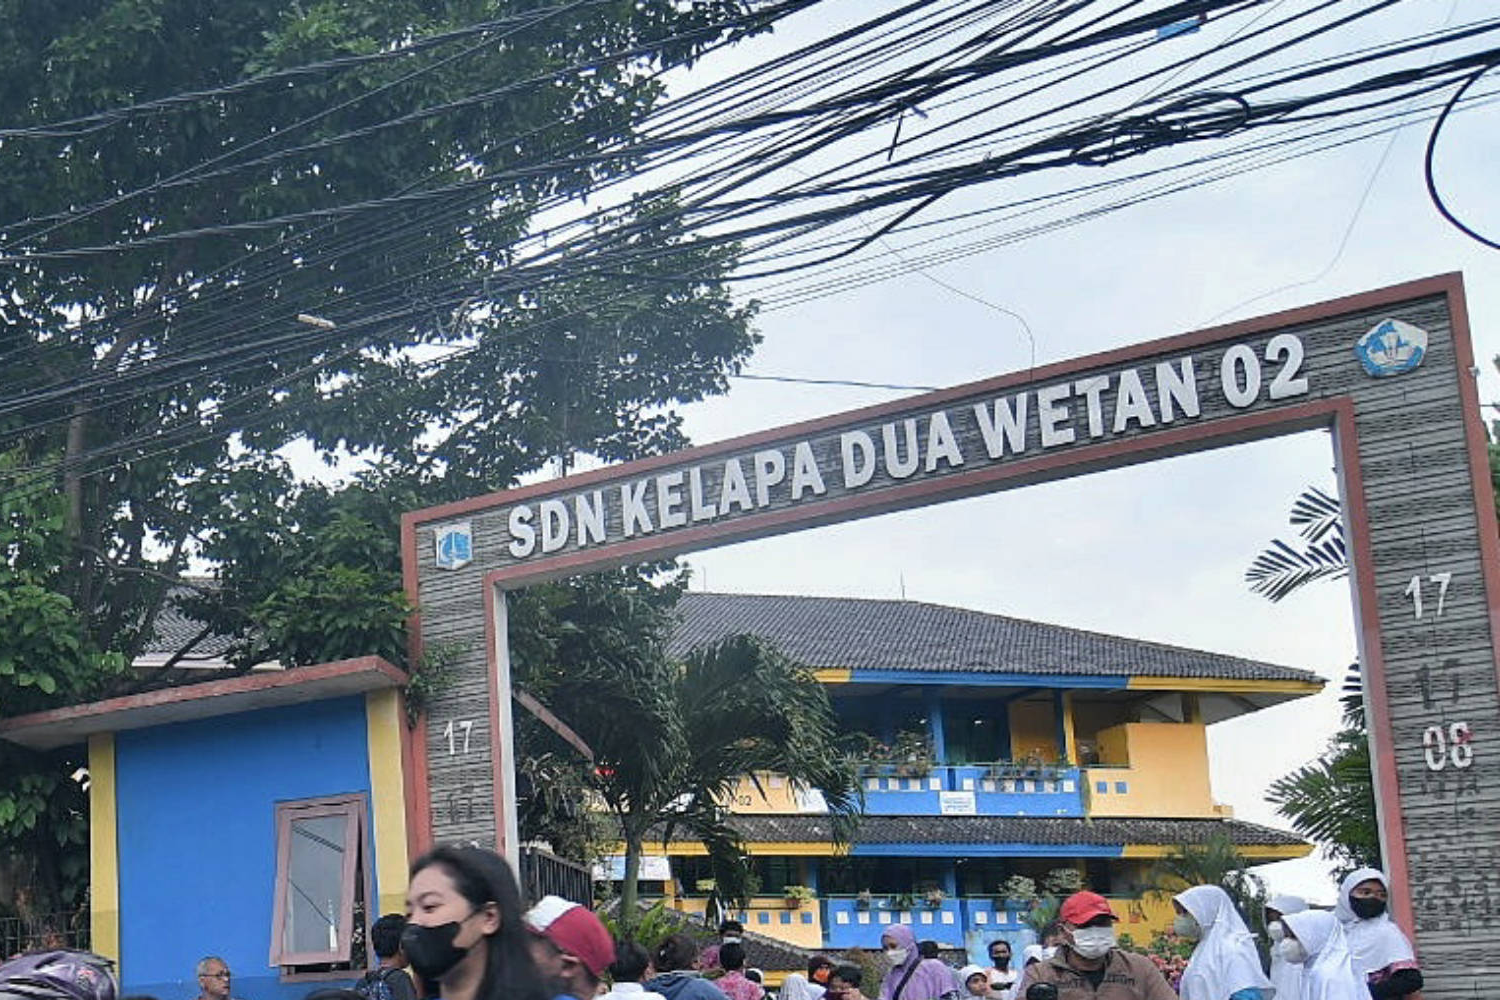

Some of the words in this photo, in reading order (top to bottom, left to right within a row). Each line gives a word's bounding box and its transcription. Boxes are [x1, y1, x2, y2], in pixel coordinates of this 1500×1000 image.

[507, 490, 606, 559] SDN
[621, 441, 826, 540] KELAPA
[840, 410, 964, 490] DUA
[974, 355, 1201, 460] WETAN
[1220, 333, 1309, 409] 02
[1405, 572, 1452, 620] 17
[444, 720, 473, 756] 17
